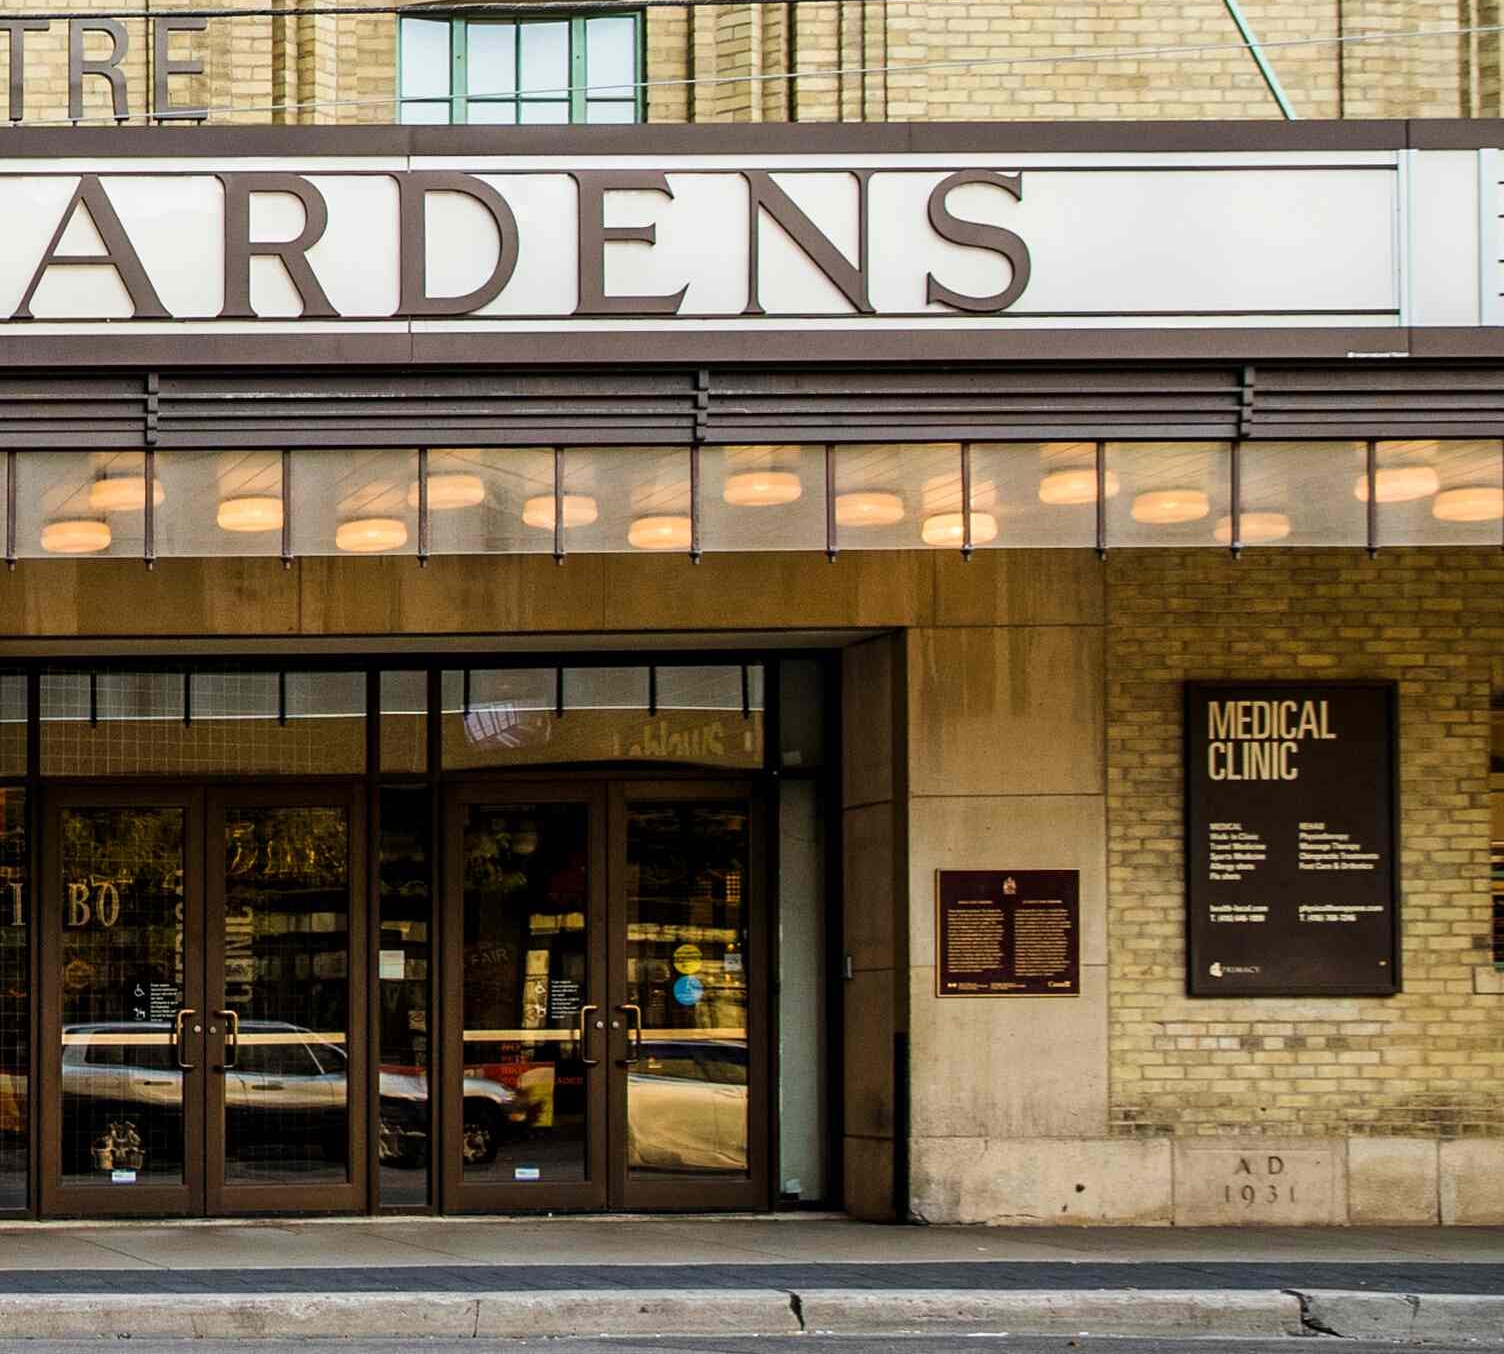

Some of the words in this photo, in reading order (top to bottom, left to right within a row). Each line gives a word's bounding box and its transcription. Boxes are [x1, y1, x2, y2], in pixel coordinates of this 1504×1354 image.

[1208, 700, 1337, 739] MEDICAL
[1208, 741, 1299, 781] CLINIC
[1267, 1156, 1285, 1176] D
[1224, 1184, 1296, 1209] 1931
